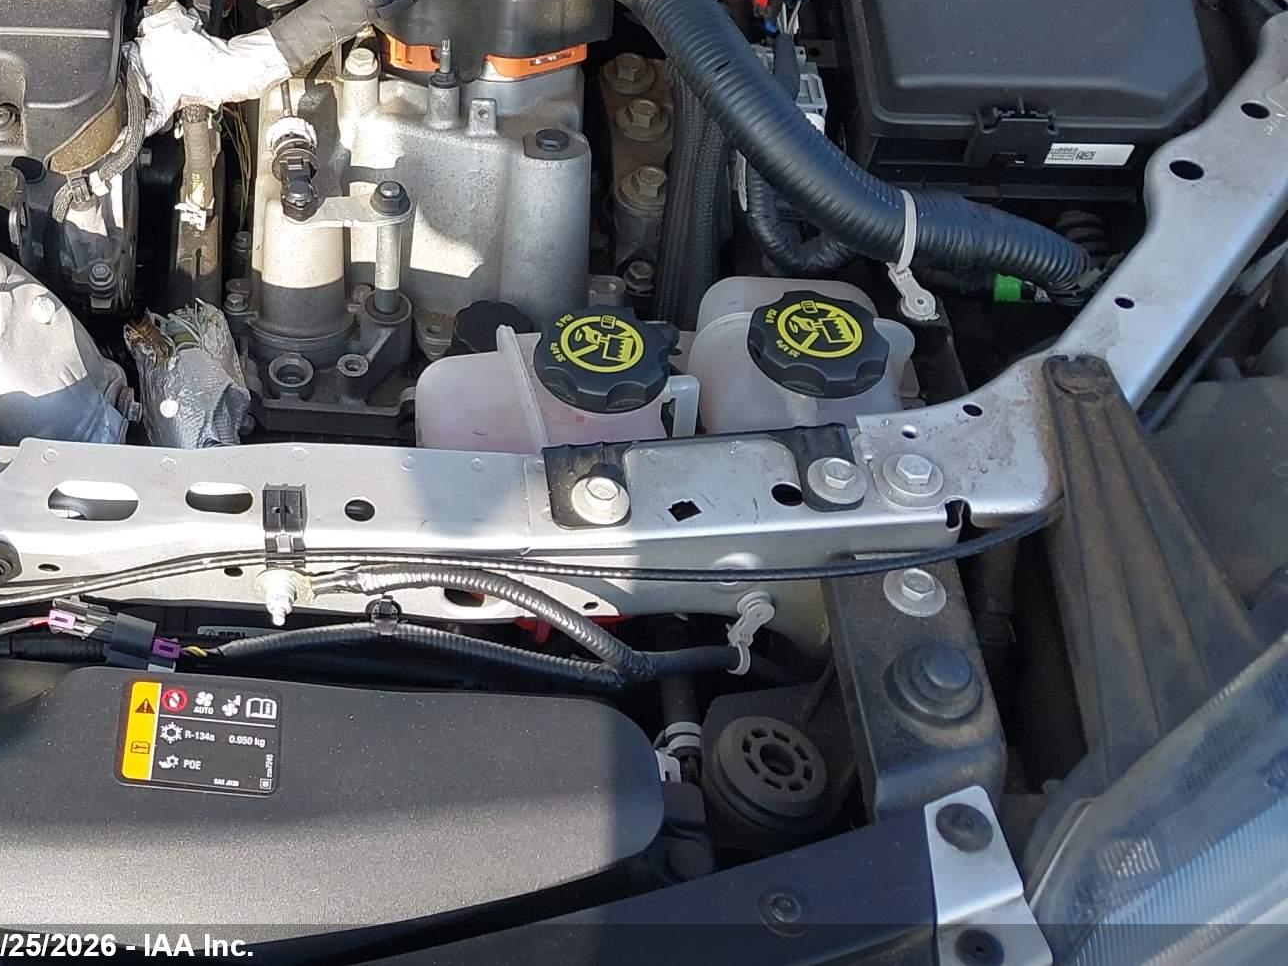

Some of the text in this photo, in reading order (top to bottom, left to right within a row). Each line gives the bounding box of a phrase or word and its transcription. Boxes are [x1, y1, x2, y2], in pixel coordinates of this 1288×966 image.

[193, 706, 214, 715] AUTO
[185, 730, 266, 748] R-134a 0.950 kg
[183, 759, 202, 770] POE
